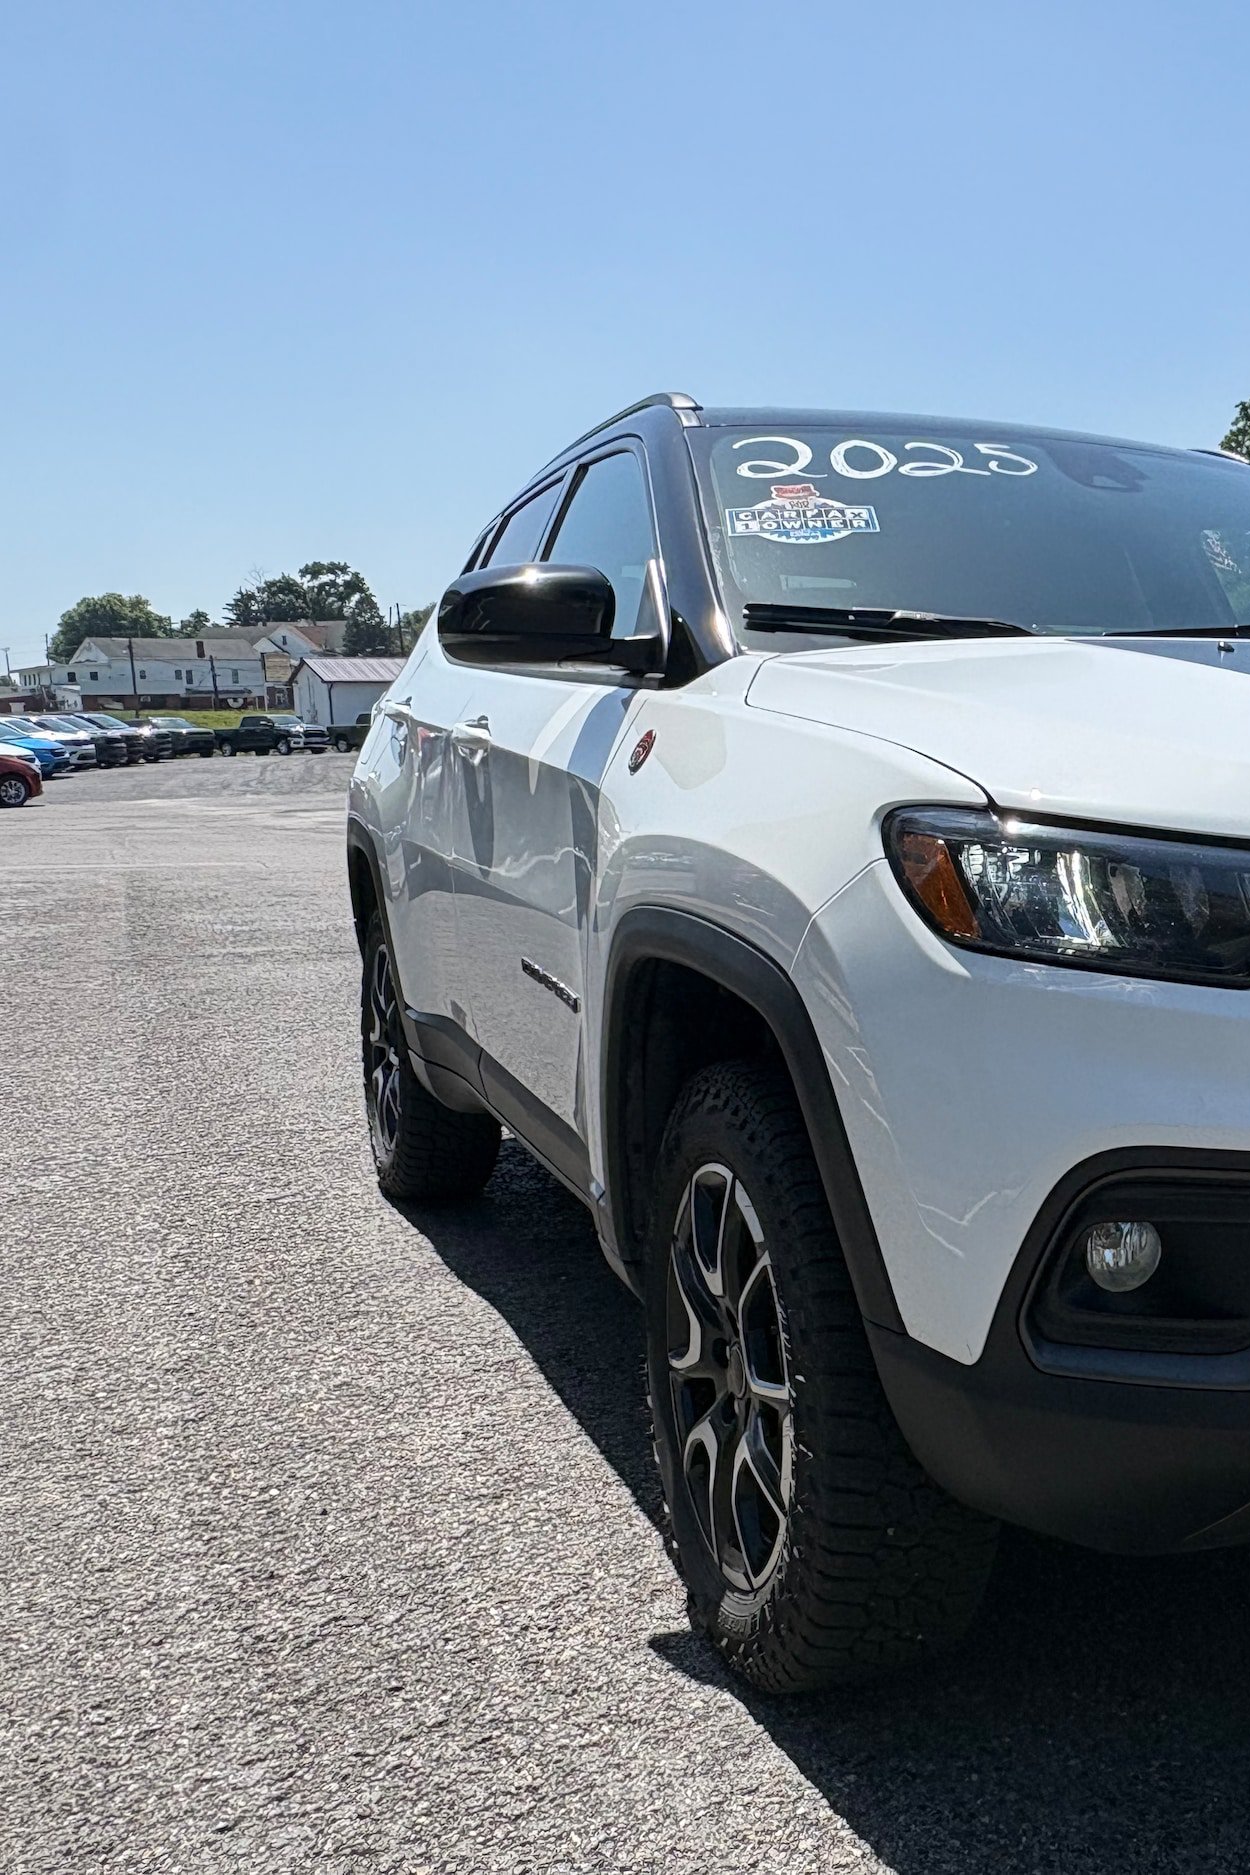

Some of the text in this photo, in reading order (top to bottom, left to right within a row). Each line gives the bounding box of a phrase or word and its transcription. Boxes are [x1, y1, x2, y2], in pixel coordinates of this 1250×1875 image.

[732, 436, 1039, 480] 2025
[738, 509, 866, 520] CARFAX
[762, 518, 867, 530] OWNER
